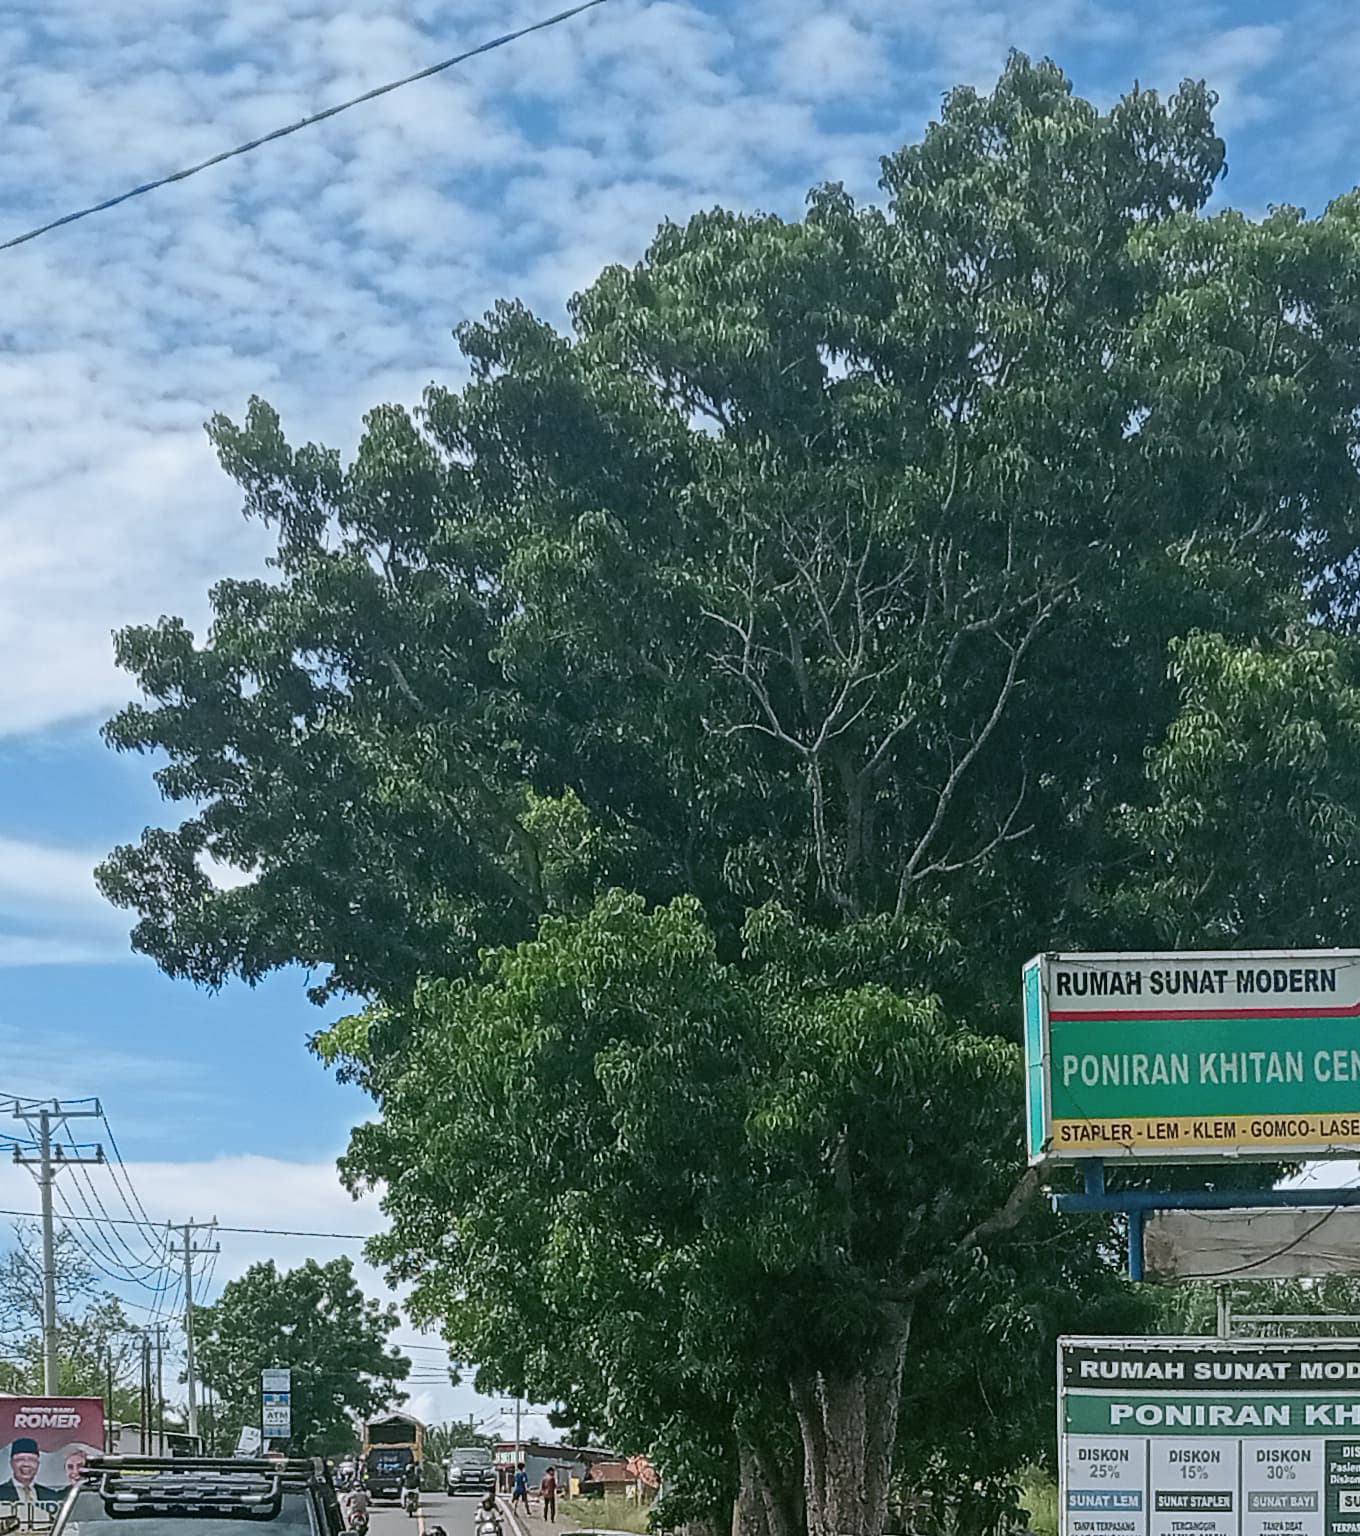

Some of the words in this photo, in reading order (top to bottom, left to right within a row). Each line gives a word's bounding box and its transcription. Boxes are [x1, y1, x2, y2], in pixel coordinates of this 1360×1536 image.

[1057, 970, 1141, 996] RUMAH
[1150, 969, 1228, 995] SUNAT
[1237, 968, 1336, 994] MODERN
[1063, 1053, 1189, 1088] PONIRAN
[1200, 1051, 1304, 1084] KHITAN
[1061, 1125, 1132, 1142] STAPLER
[1147, 1123, 1179, 1140] LEM
[1194, 1121, 1236, 1139] KLEM
[1080, 1360, 1184, 1380] RUMAH
[1194, 1362, 1291, 1380] SUNAT
[14, 1413, 81, 1428] ROMER
[267, 1411, 289, 1419] ATM
[1110, 1404, 1290, 1426] PONIRAN
[1078, 1448, 1129, 1461] DISKON
[1169, 1450, 1220, 1463] DISKON
[1257, 1450, 1311, 1462] DISKON
[1090, 1465, 1120, 1478] 25%
[1180, 1466, 1209, 1479] 15%
[1267, 1465, 1296, 1480] 30%
[1069, 1495, 1110, 1507] SUNAT
[1114, 1495, 1139, 1507] LEM
[1158, 1496, 1188, 1508] SUNAT
[1191, 1496, 1230, 1508] STAPLER
[1253, 1496, 1288, 1507] SUNAT
[1290, 1496, 1315, 1507] BAYI
